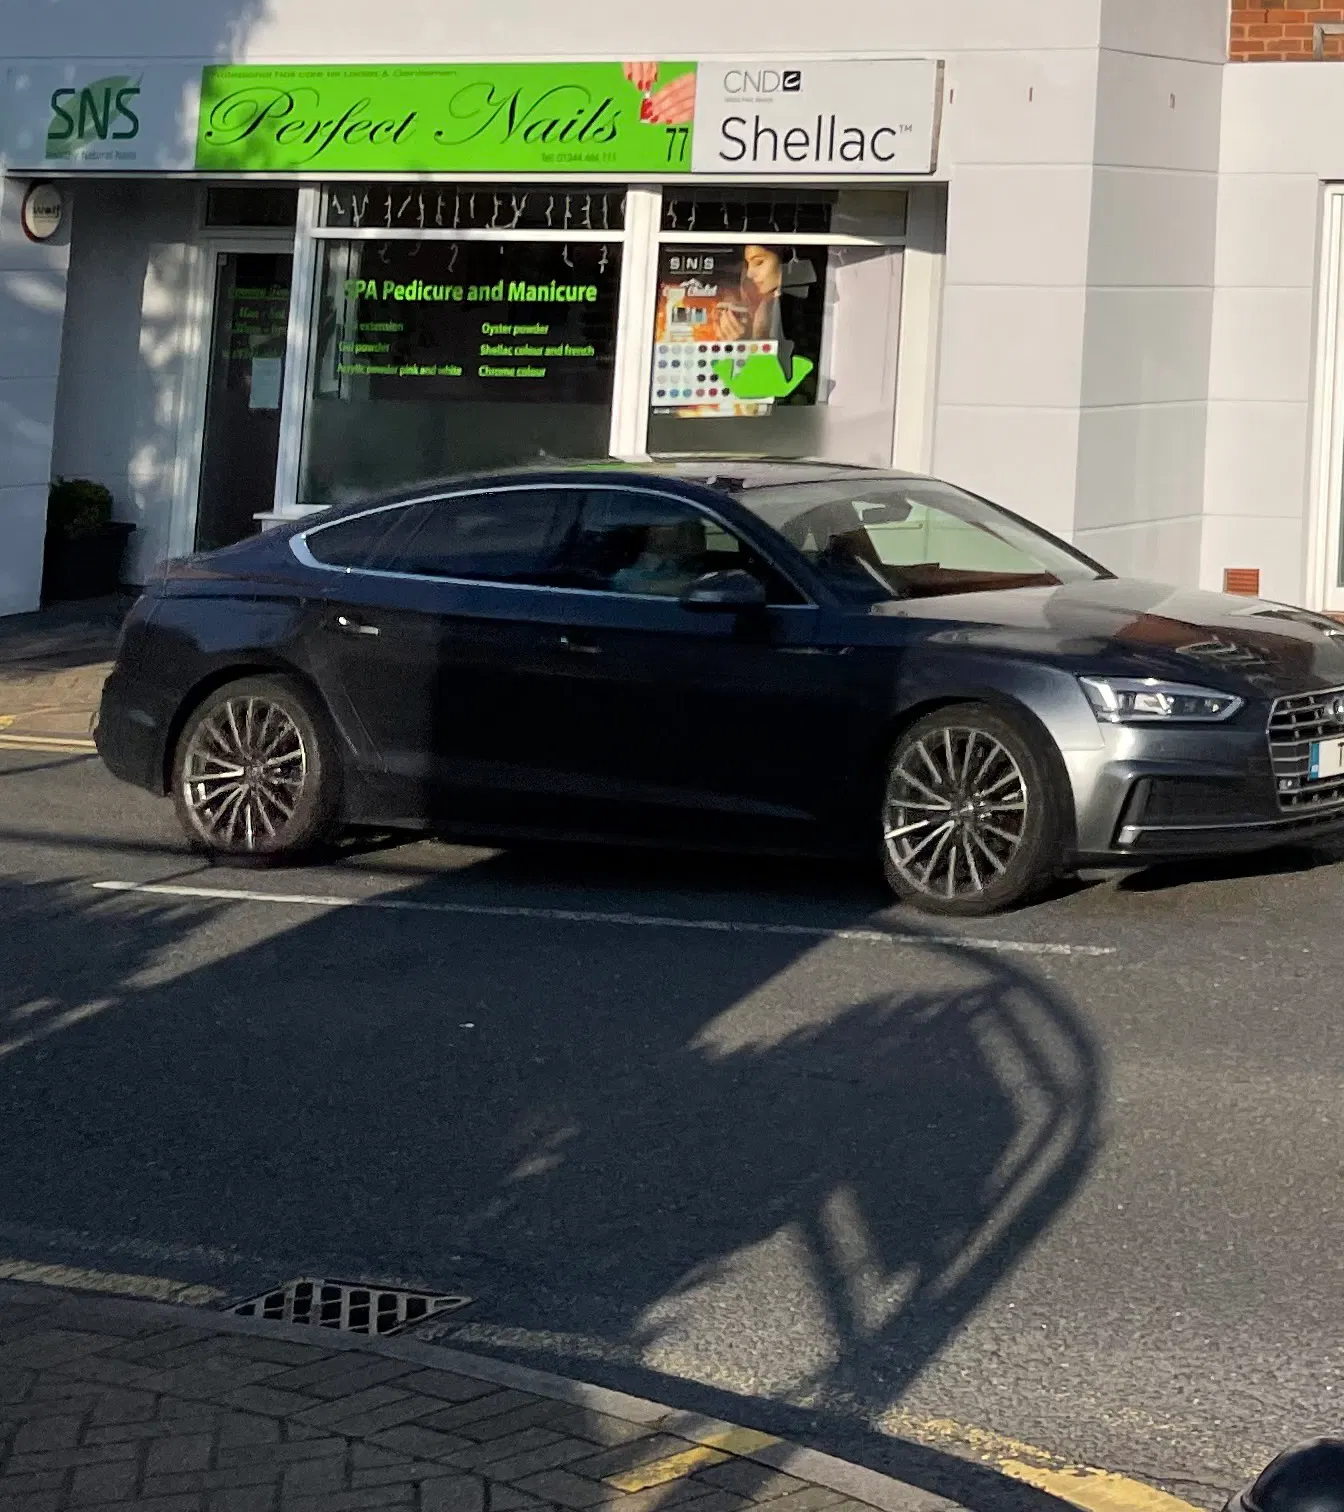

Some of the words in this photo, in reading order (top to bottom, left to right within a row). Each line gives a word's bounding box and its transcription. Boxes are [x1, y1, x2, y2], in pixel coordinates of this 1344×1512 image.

[47, 87, 141, 140] SNS
[204, 86, 418, 165] Perfect
[433, 81, 622, 145] Nails
[665, 127, 689, 163] 77
[718, 114, 897, 162] Shellac
[344, 279, 378, 301] SPA
[382, 279, 464, 302] Pedicure
[466, 279, 504, 302] and
[507, 279, 598, 302] Manicure
